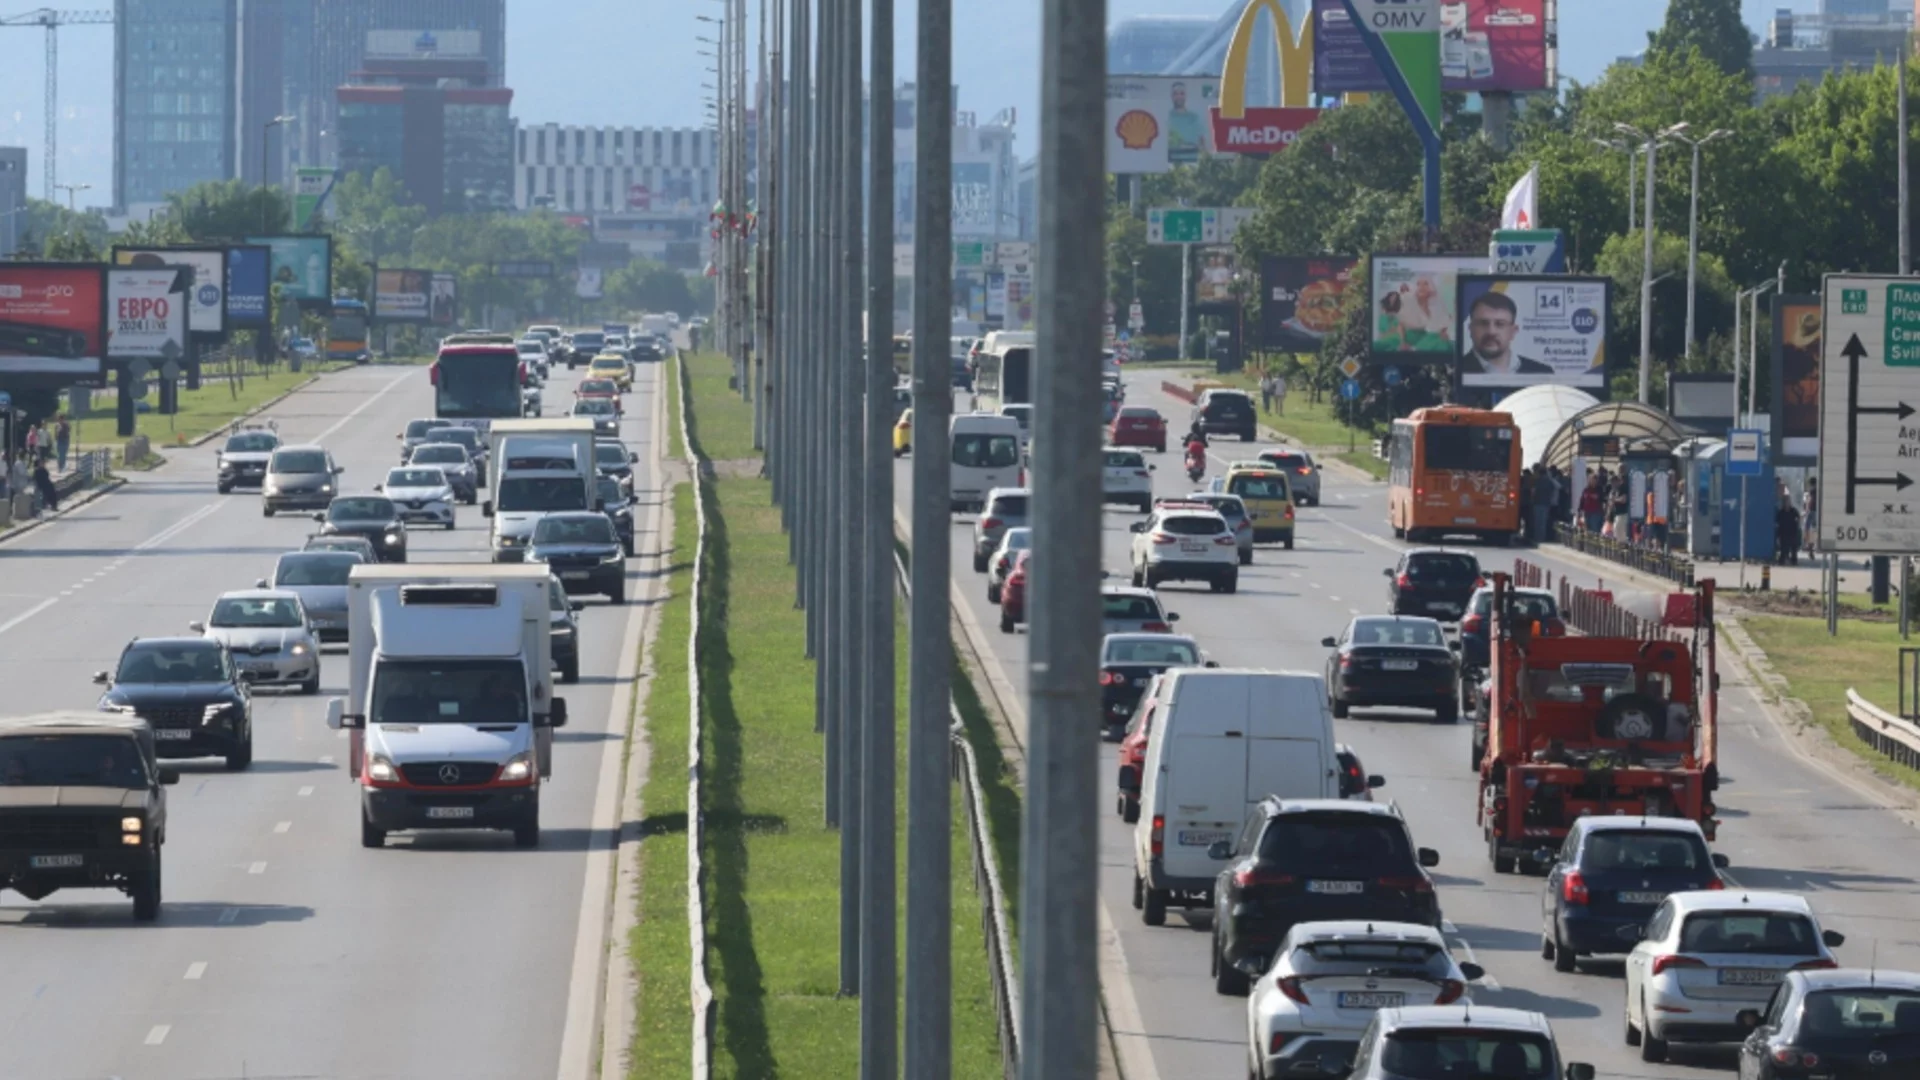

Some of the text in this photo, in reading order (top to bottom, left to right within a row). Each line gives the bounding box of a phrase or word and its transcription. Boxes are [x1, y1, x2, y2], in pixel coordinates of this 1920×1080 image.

[1372, 11, 1426, 28] OMV
[1497, 261, 1535, 273] OMV
[117, 297, 169, 320] ЕВРО
[1540, 295, 1560, 309] 14
[1836, 525, 1869, 541] 500
